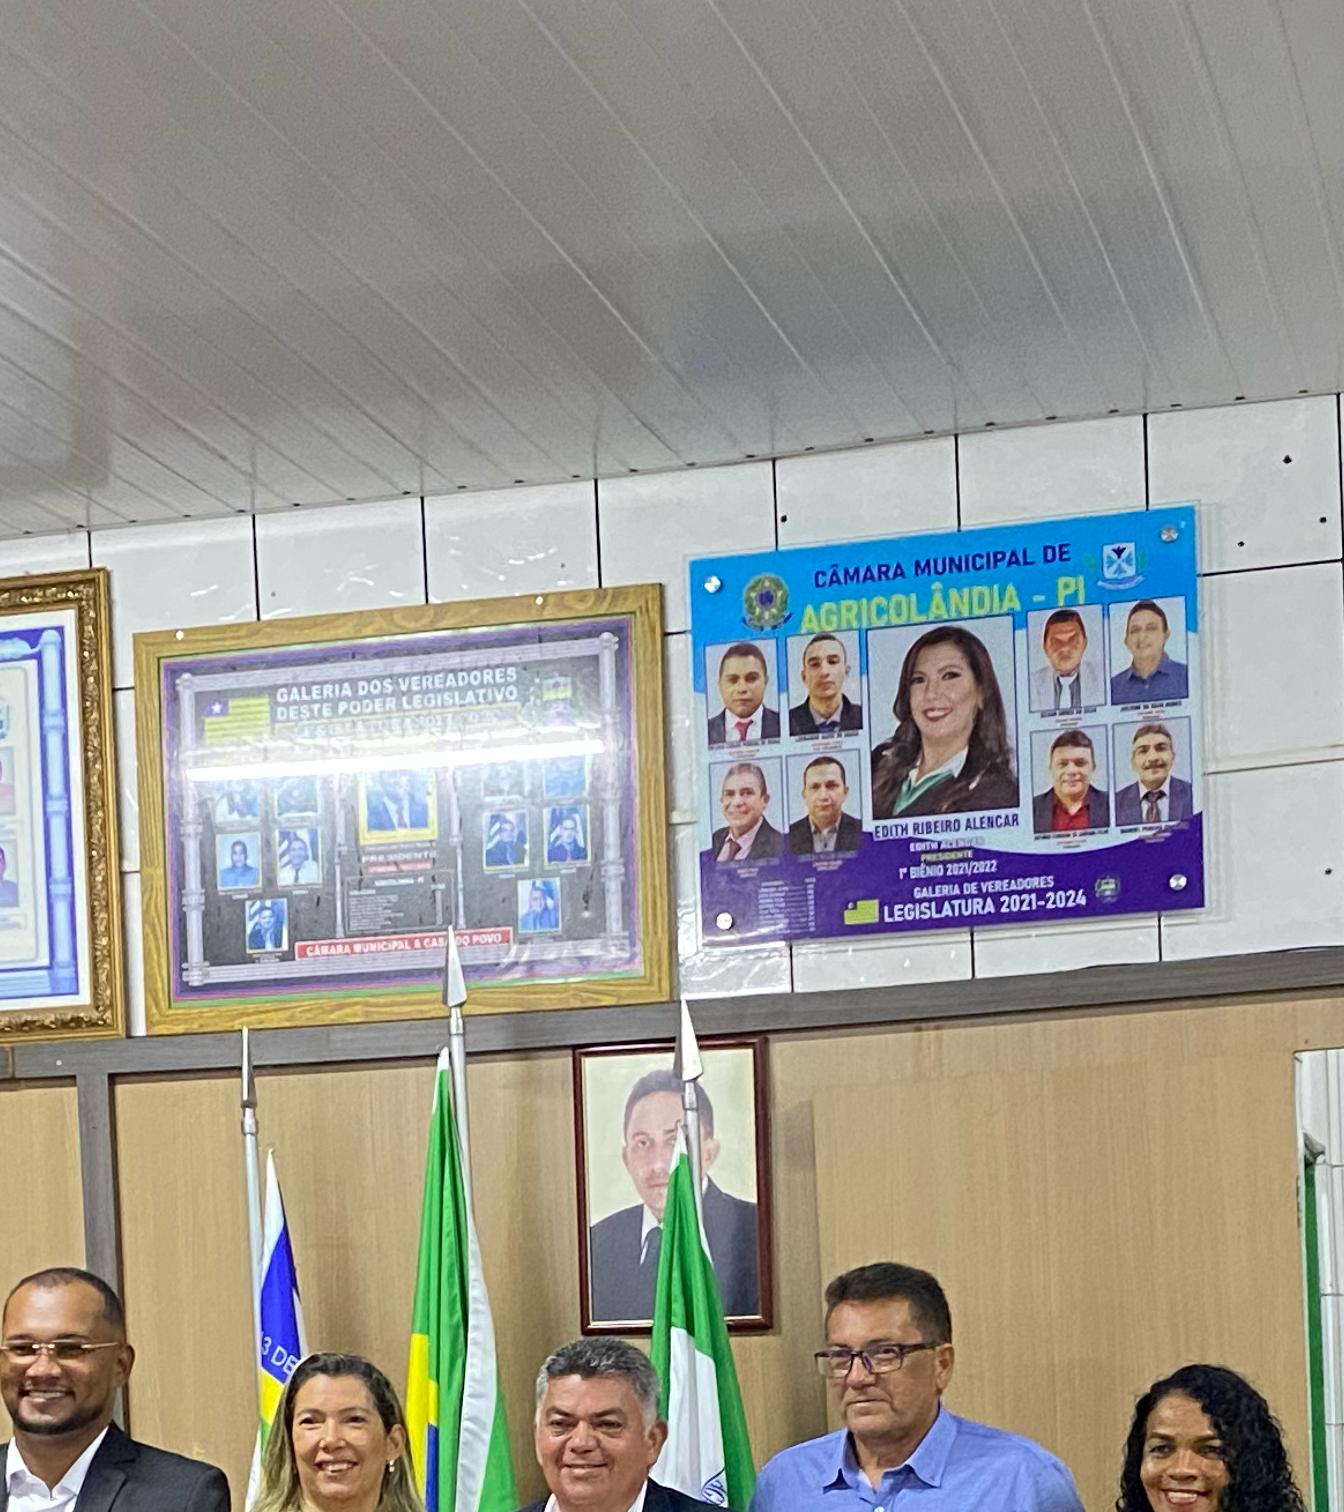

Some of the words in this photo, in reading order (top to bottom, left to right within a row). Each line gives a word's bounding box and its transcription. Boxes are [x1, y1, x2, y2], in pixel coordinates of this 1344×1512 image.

[814, 562, 906, 588] CÂMARA
[914, 548, 1035, 578] MUNICIPAL
[1042, 543, 1071, 563] DE
[800, 581, 1022, 633] AGRICOLÂNDIA
[1057, 575, 1086, 606] PI
[276, 682, 352, 704] GALERIA
[358, 678, 393, 697] DOS
[398, 667, 518, 692] VEREADORES
[276, 701, 333, 721] DESTE
[338, 696, 396, 716] PODER
[402, 685, 518, 710] LEGISLATIVO
[874, 822, 909, 840] EDITH
[913, 818, 961, 836] RIBEIRO
[964, 813, 1020, 832] ALENCAR
[946, 859, 998, 877] 2021/2022
[913, 883, 959, 899] GALERIA
[963, 881, 978, 894] DE
[981, 875, 1054, 894] VEREADORES
[883, 898, 995, 923] LEGISLATURA
[1000, 889, 1087, 913] 2021-2024
